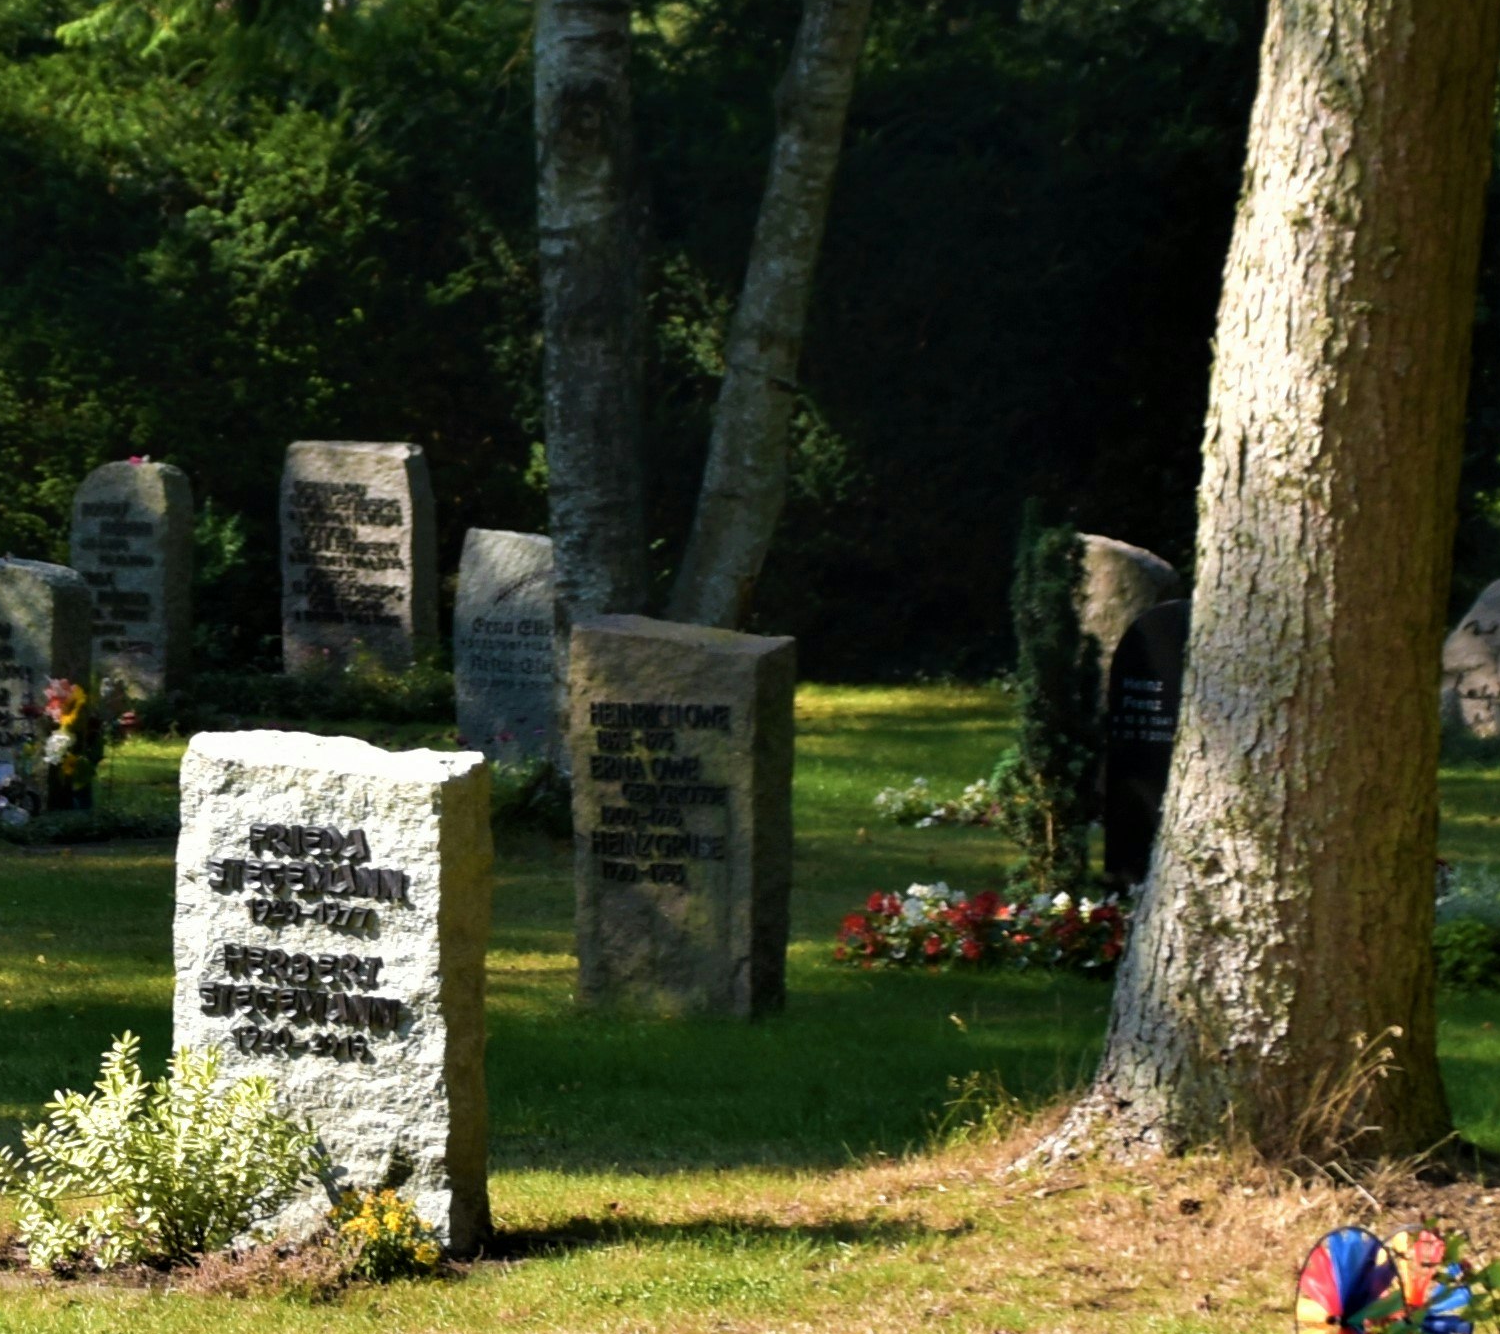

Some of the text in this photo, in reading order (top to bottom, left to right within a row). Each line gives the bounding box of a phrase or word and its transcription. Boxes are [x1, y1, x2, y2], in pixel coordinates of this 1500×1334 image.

[591, 703, 682, 729] HEINRICH
[590, 756, 647, 781] ERNA
[250, 822, 370, 862] FRIEDA
[592, 830, 650, 857] HEINZ
[208, 858, 410, 900] STEGEMANN
[224, 943, 385, 990] HERBERT
[199, 982, 405, 1030] STEGEMANN
